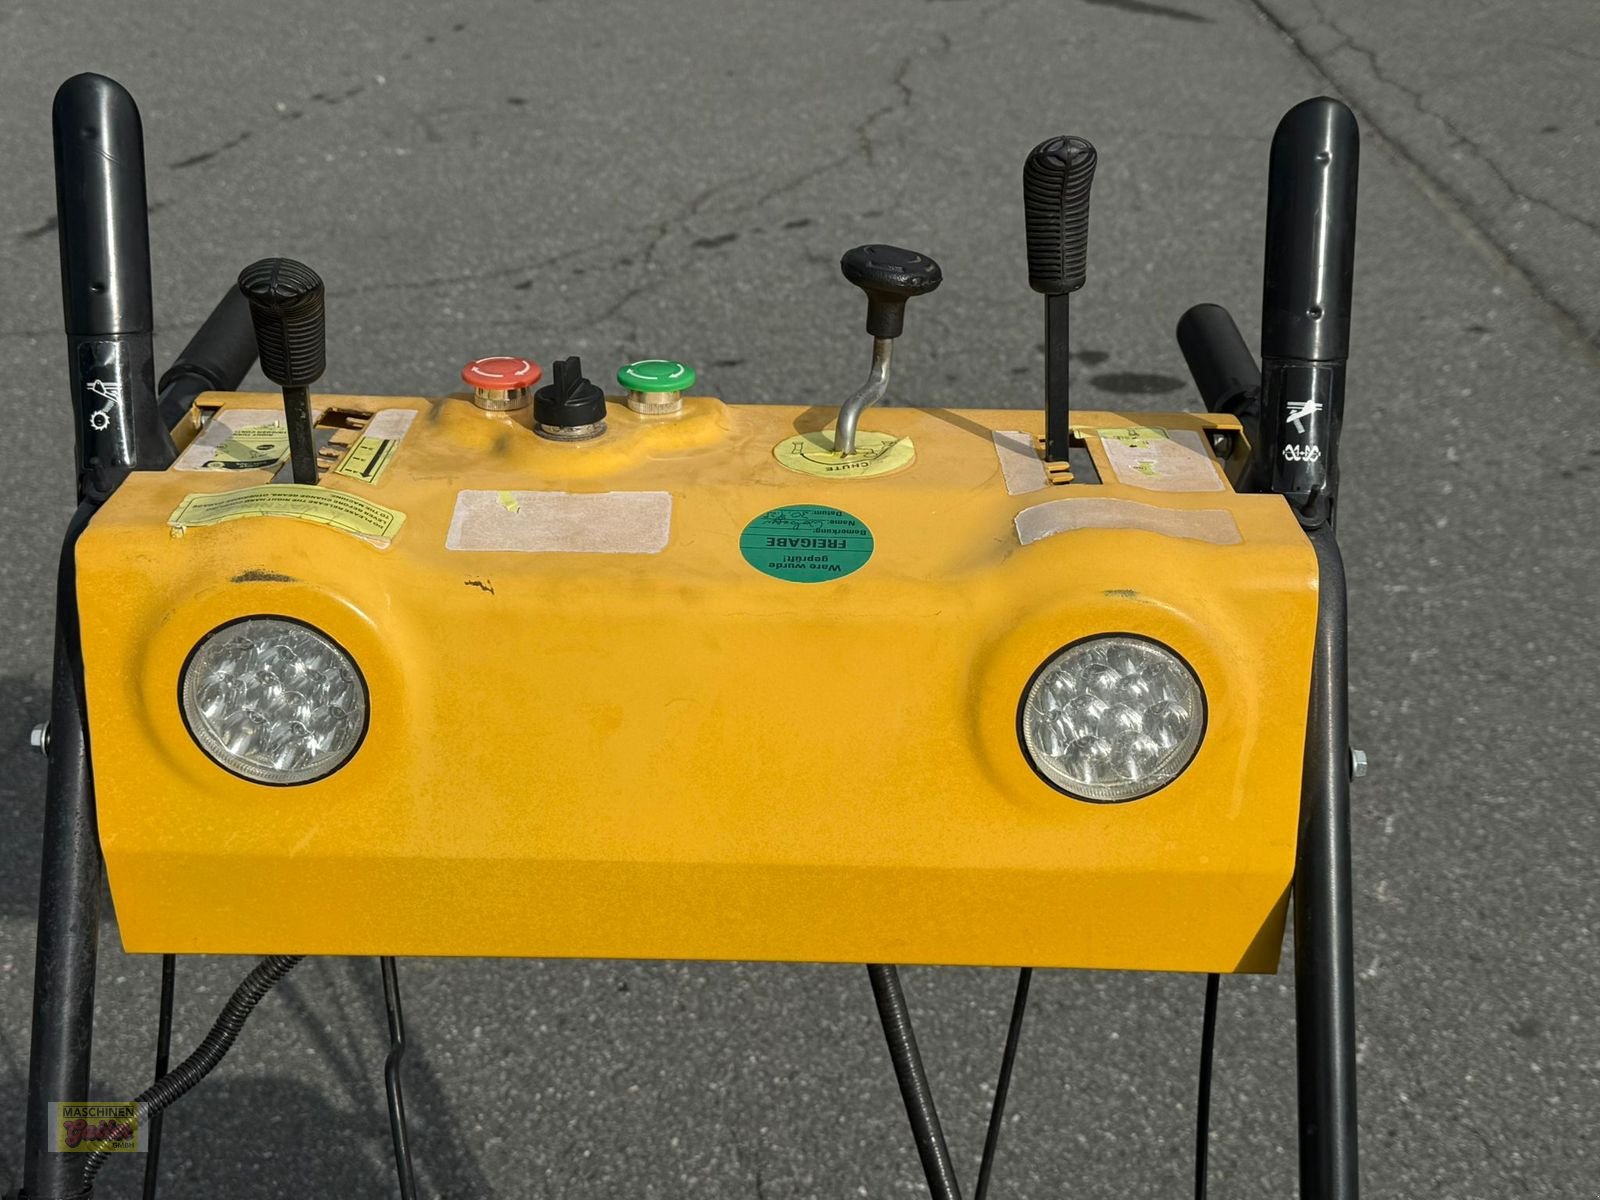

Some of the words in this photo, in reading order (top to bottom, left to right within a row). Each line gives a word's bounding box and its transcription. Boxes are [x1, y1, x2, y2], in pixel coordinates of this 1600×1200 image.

[825, 462, 869, 472] CHUTE
[300, 494, 332, 503] CHANGE
[308, 500, 343, 511] RELEASE
[333, 499, 363, 513] BEFORE
[365, 506, 379, 515] THE
[344, 508, 372, 523] PLEASE
[364, 510, 387, 525] LEVER
[827, 519, 856, 527] Name:
[813, 528, 867, 536] Bemerkung:
[766, 537, 847, 549] FREIGABE
[783, 555, 828, 563] geprüft!
[768, 562, 806, 570] wurde
[809, 563, 841, 572] Ware
